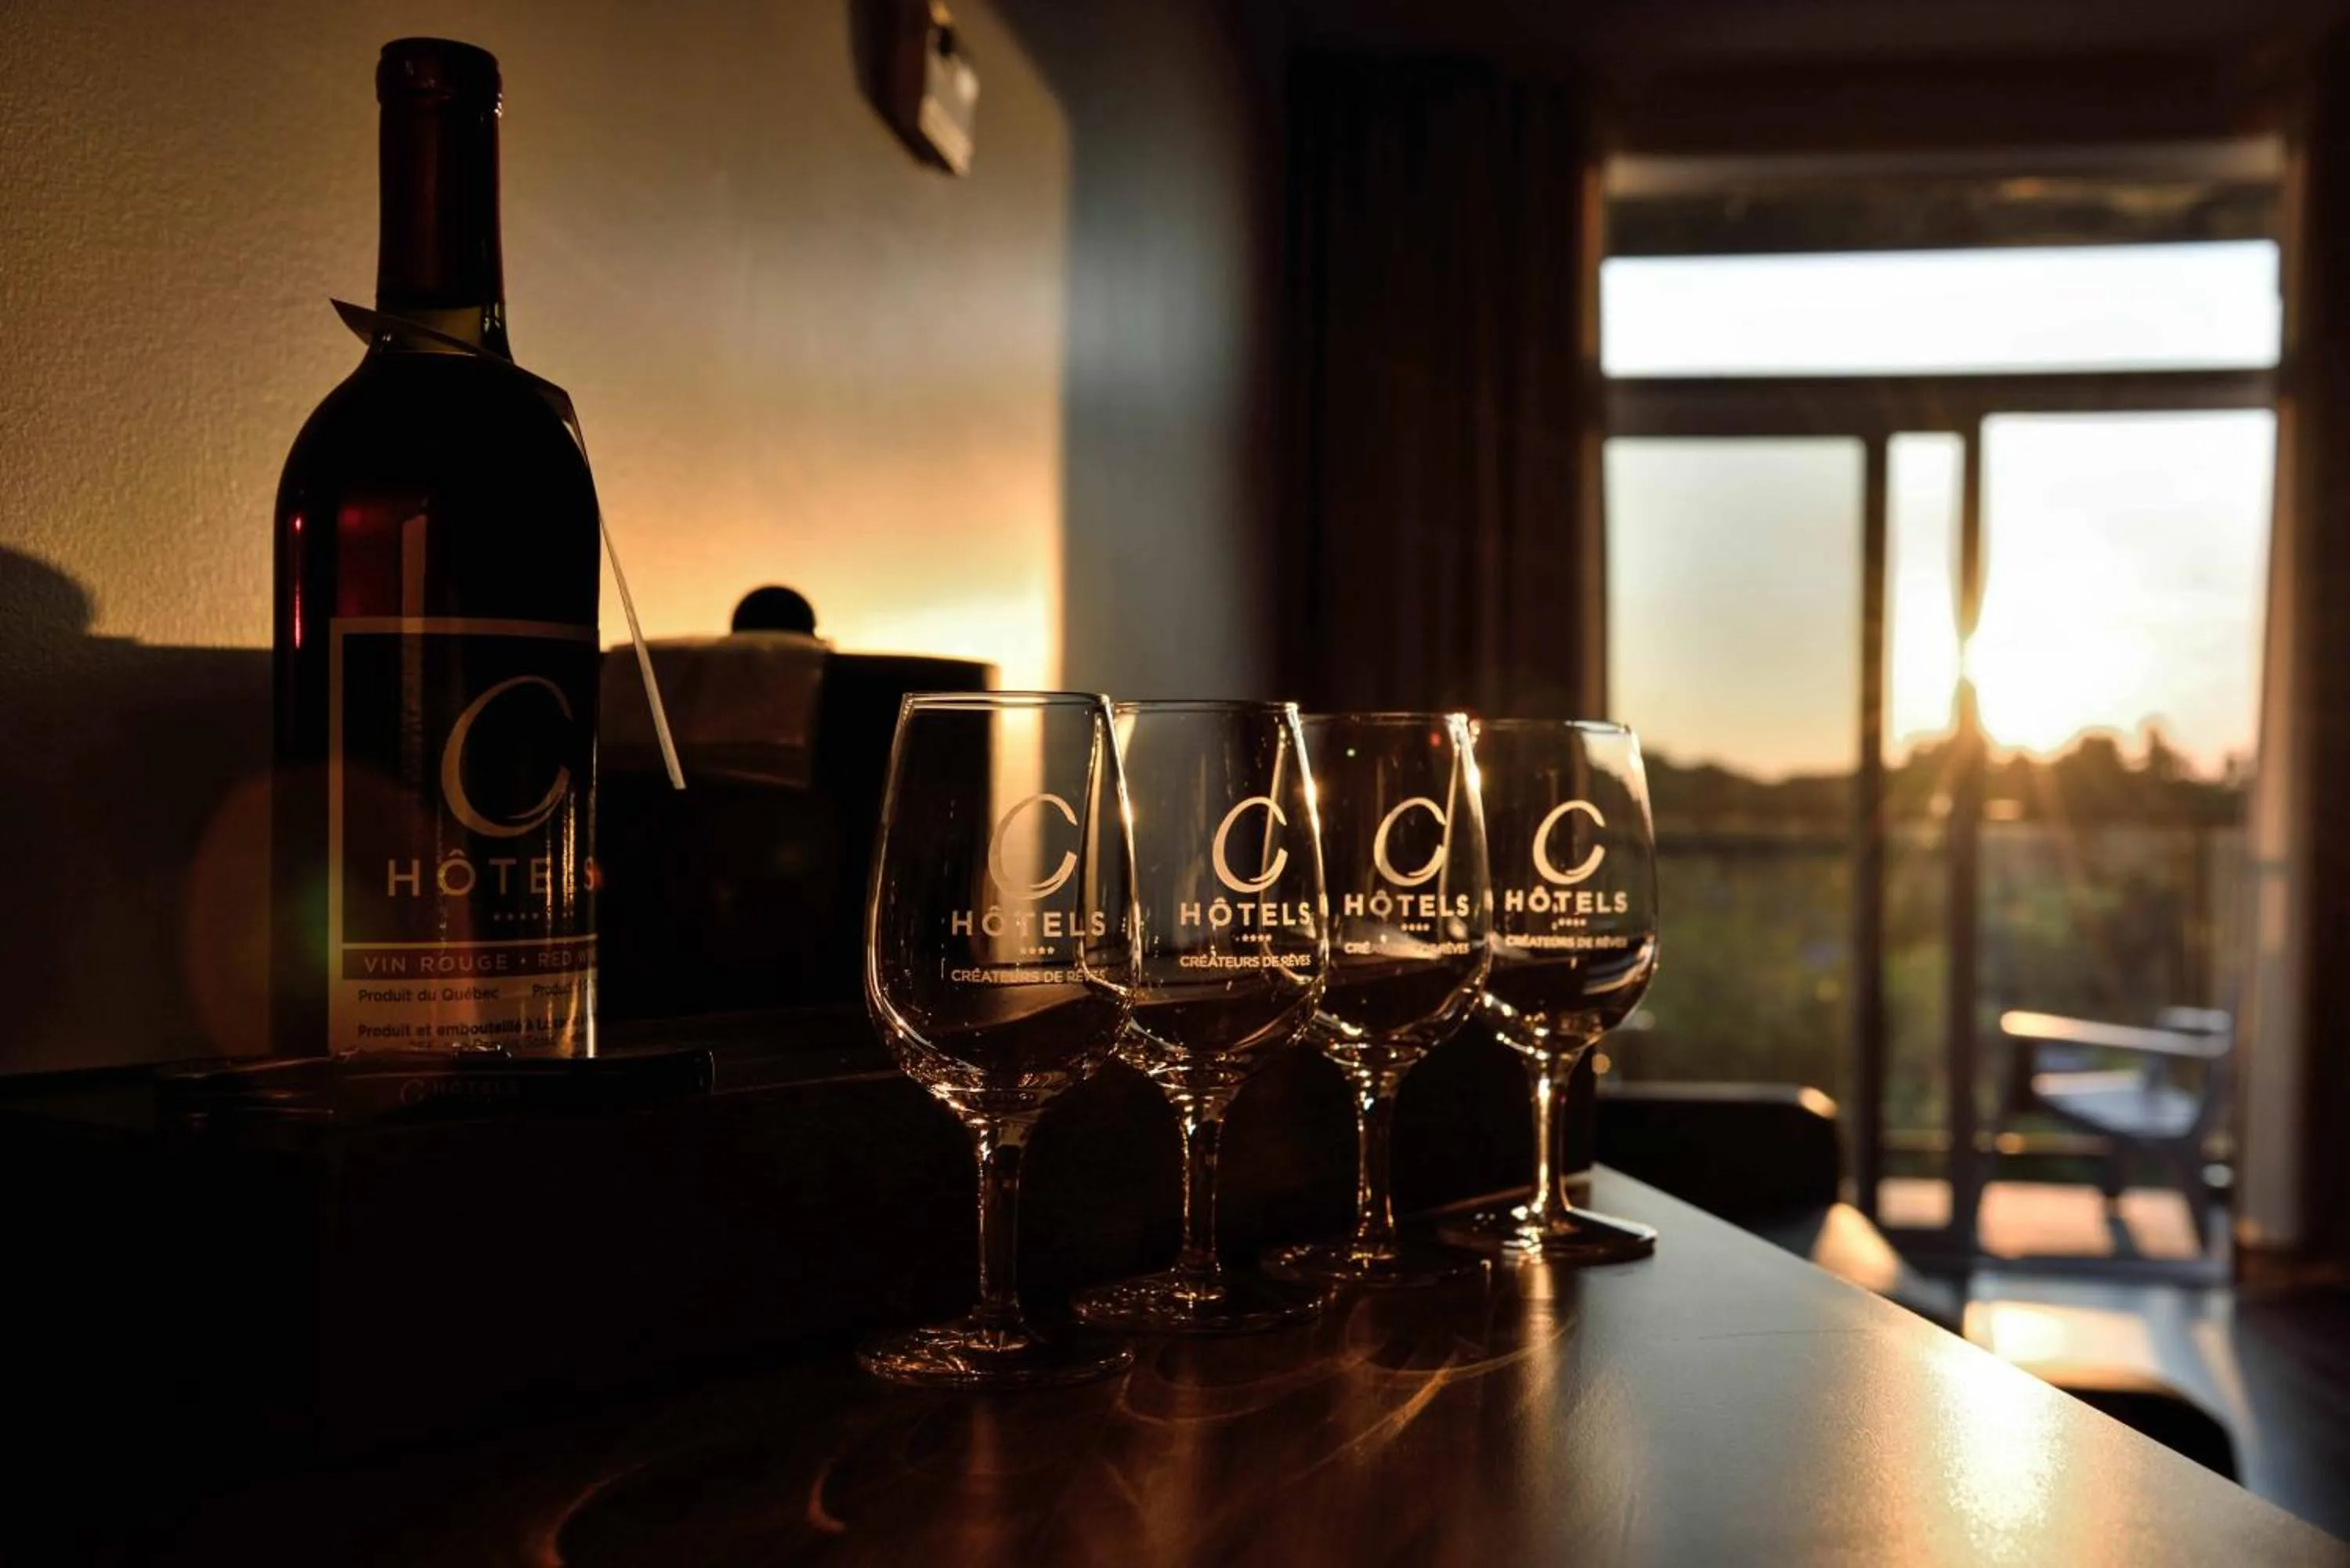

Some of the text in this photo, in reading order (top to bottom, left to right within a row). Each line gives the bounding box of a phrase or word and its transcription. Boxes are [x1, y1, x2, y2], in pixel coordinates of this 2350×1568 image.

[440, 672, 575, 838] C
[988, 793, 1078, 901] C
[1212, 795, 1289, 894] C
[1373, 796, 1448, 887] C
[1532, 799, 1607, 885] C
[387, 848, 600, 898] HÔTES
[1180, 896, 1312, 927] HÔTELS
[1343, 889, 1470, 918] HÔTELS
[1505, 884, 1629, 914] HÔTELS
[951, 905, 1107, 938] HÔTELS
[363, 954, 406, 973] VIN
[420, 952, 509, 972] ROUGE
[537, 948, 573, 969] RED
[950, 967, 1040, 984] CRÉATEURS
[1043, 970, 1063, 983] DE
[1179, 954, 1260, 968] CRÉATEURS
[1262, 955, 1280, 967] DE
[358, 989, 412, 1003] Produit
[417, 988, 437, 1002] du
[442, 986, 500, 1003] Québec
[358, 1024, 410, 1037] Produit
[416, 1023, 432, 1035] et
